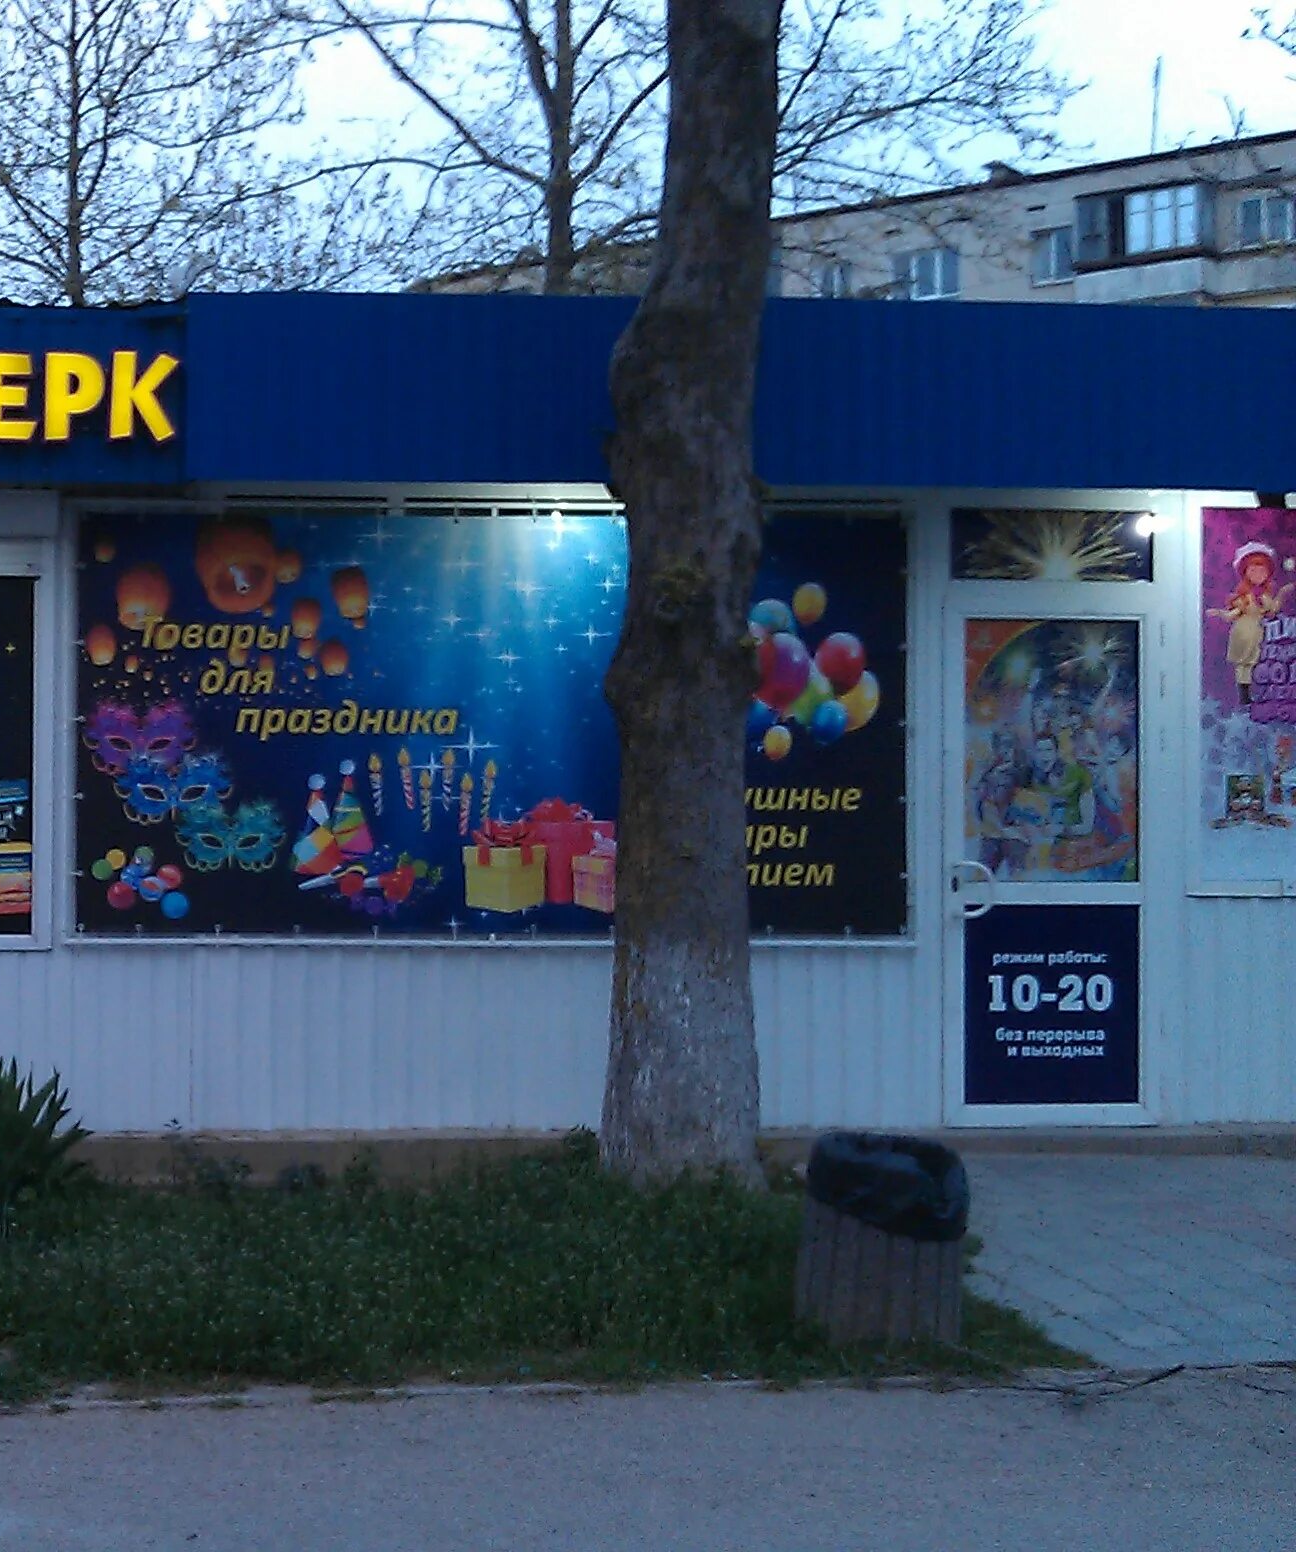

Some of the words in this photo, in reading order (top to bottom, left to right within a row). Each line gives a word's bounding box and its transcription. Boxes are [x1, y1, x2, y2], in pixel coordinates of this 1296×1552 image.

[141, 616, 292, 654] Товары
[200, 658, 276, 695] для
[235, 699, 459, 742] праздника
[992, 952, 1045, 966] режим
[1048, 950, 1108, 966] работы:
[987, 974, 1113, 1012] 10-20
[995, 1027, 1024, 1041] без
[1027, 1028, 1106, 1043] перерыва
[1007, 1046, 1018, 1056] и
[1021, 1045, 1105, 1058] выходных
